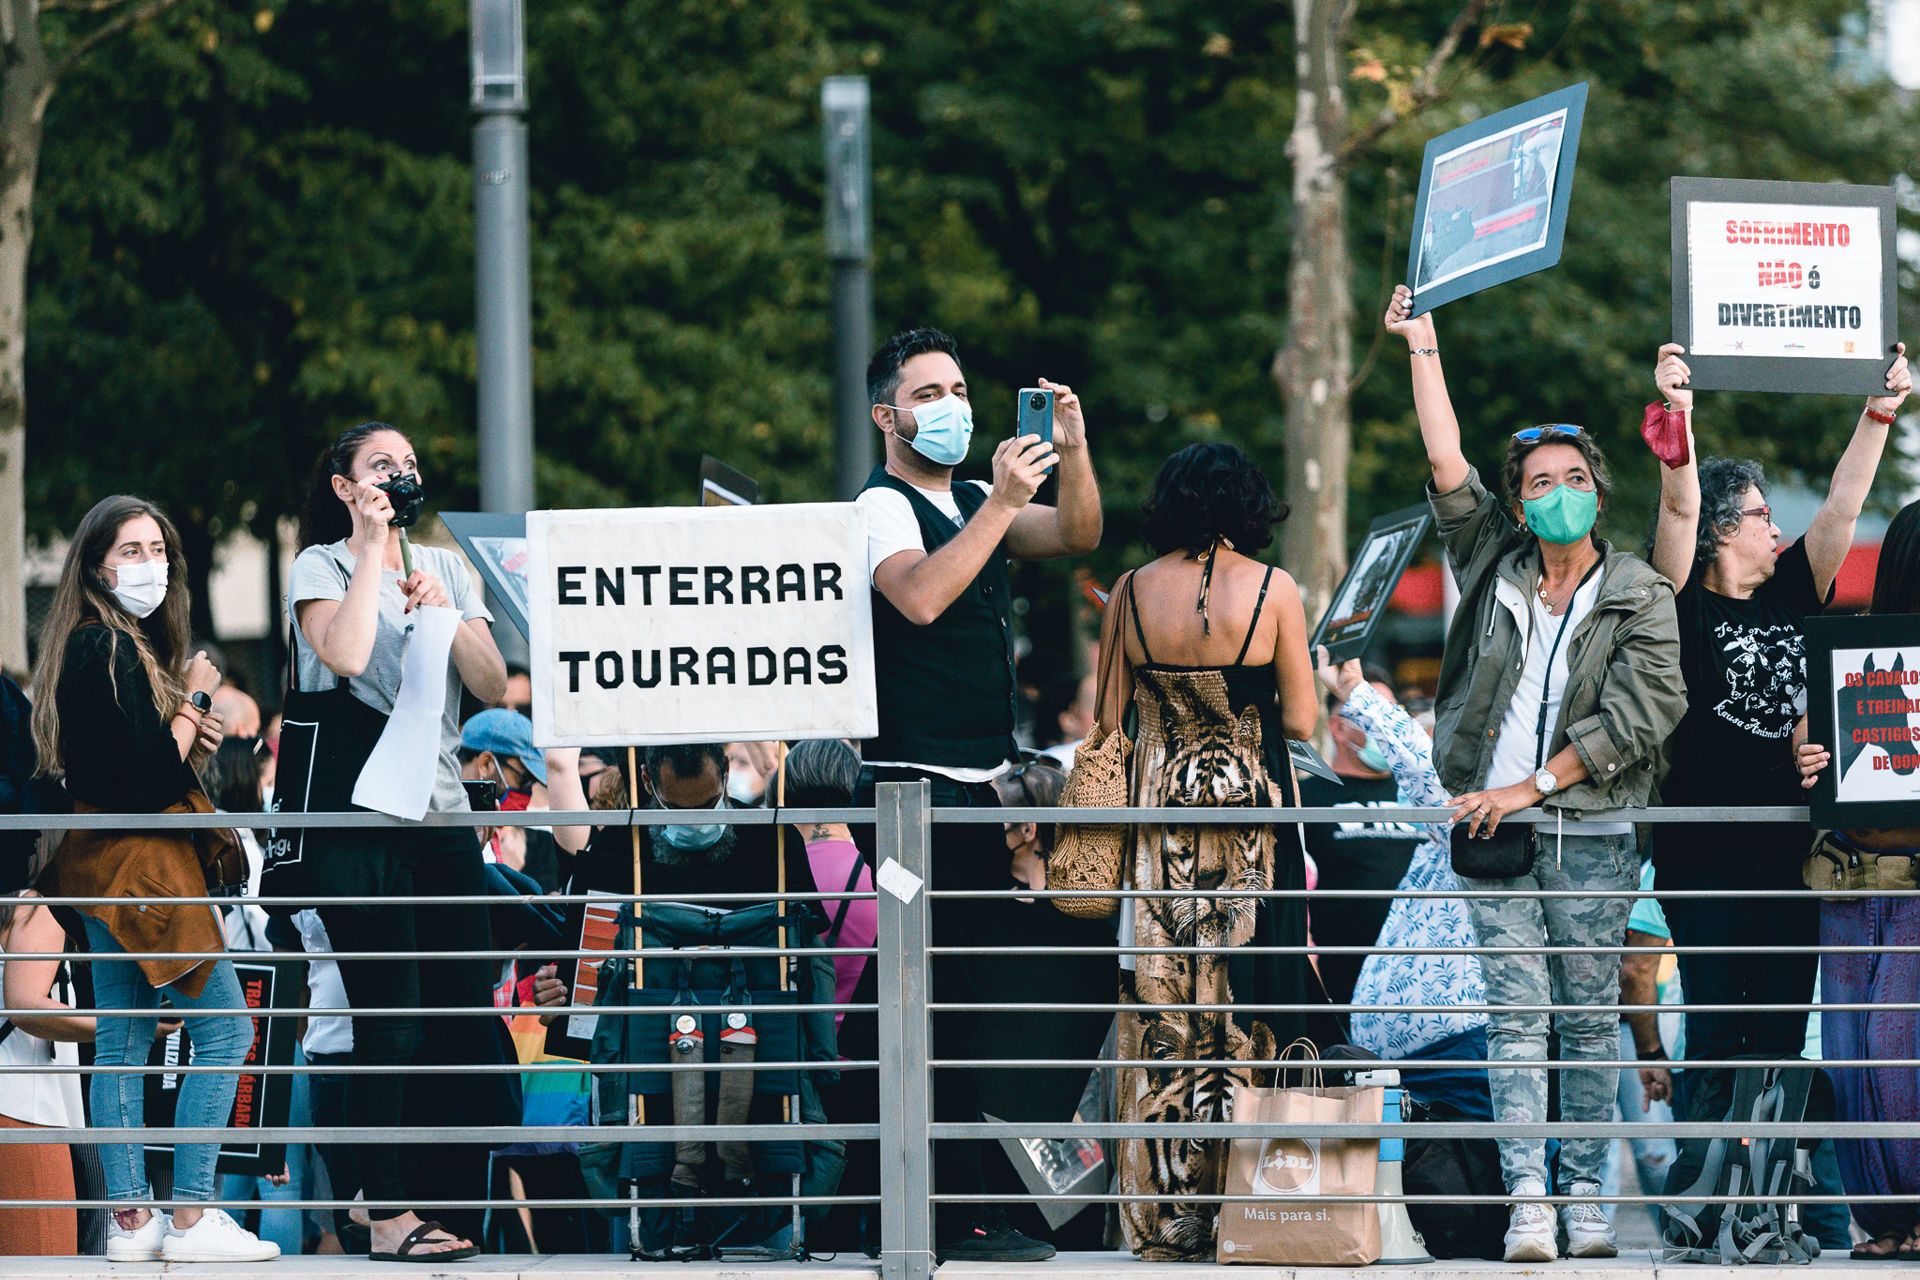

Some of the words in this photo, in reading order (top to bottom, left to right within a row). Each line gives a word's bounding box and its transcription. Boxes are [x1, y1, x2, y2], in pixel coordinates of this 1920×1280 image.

[1726, 220, 1850, 247] SOFRIMENTO
[1758, 259, 1803, 289] NÃO
[1808, 265, 1821, 289] é
[1718, 303, 1861, 329] DIVERTIMENTO
[557, 562, 843, 606] ENTERRAR
[558, 645, 848, 693] TOURADAS
[1845, 671, 1864, 687] OS
[1866, 670, 1920, 686] CAVALO
[1856, 700, 1864, 715] E
[1744, 717, 1782, 738] Animal
[1852, 727, 1920, 743] CASTIGOS
[1873, 755, 1890, 771] DE
[1244, 1208, 1276, 1221] Mais
[1280, 1210, 1312, 1224] para
[1315, 1208, 1331, 1221] si.
